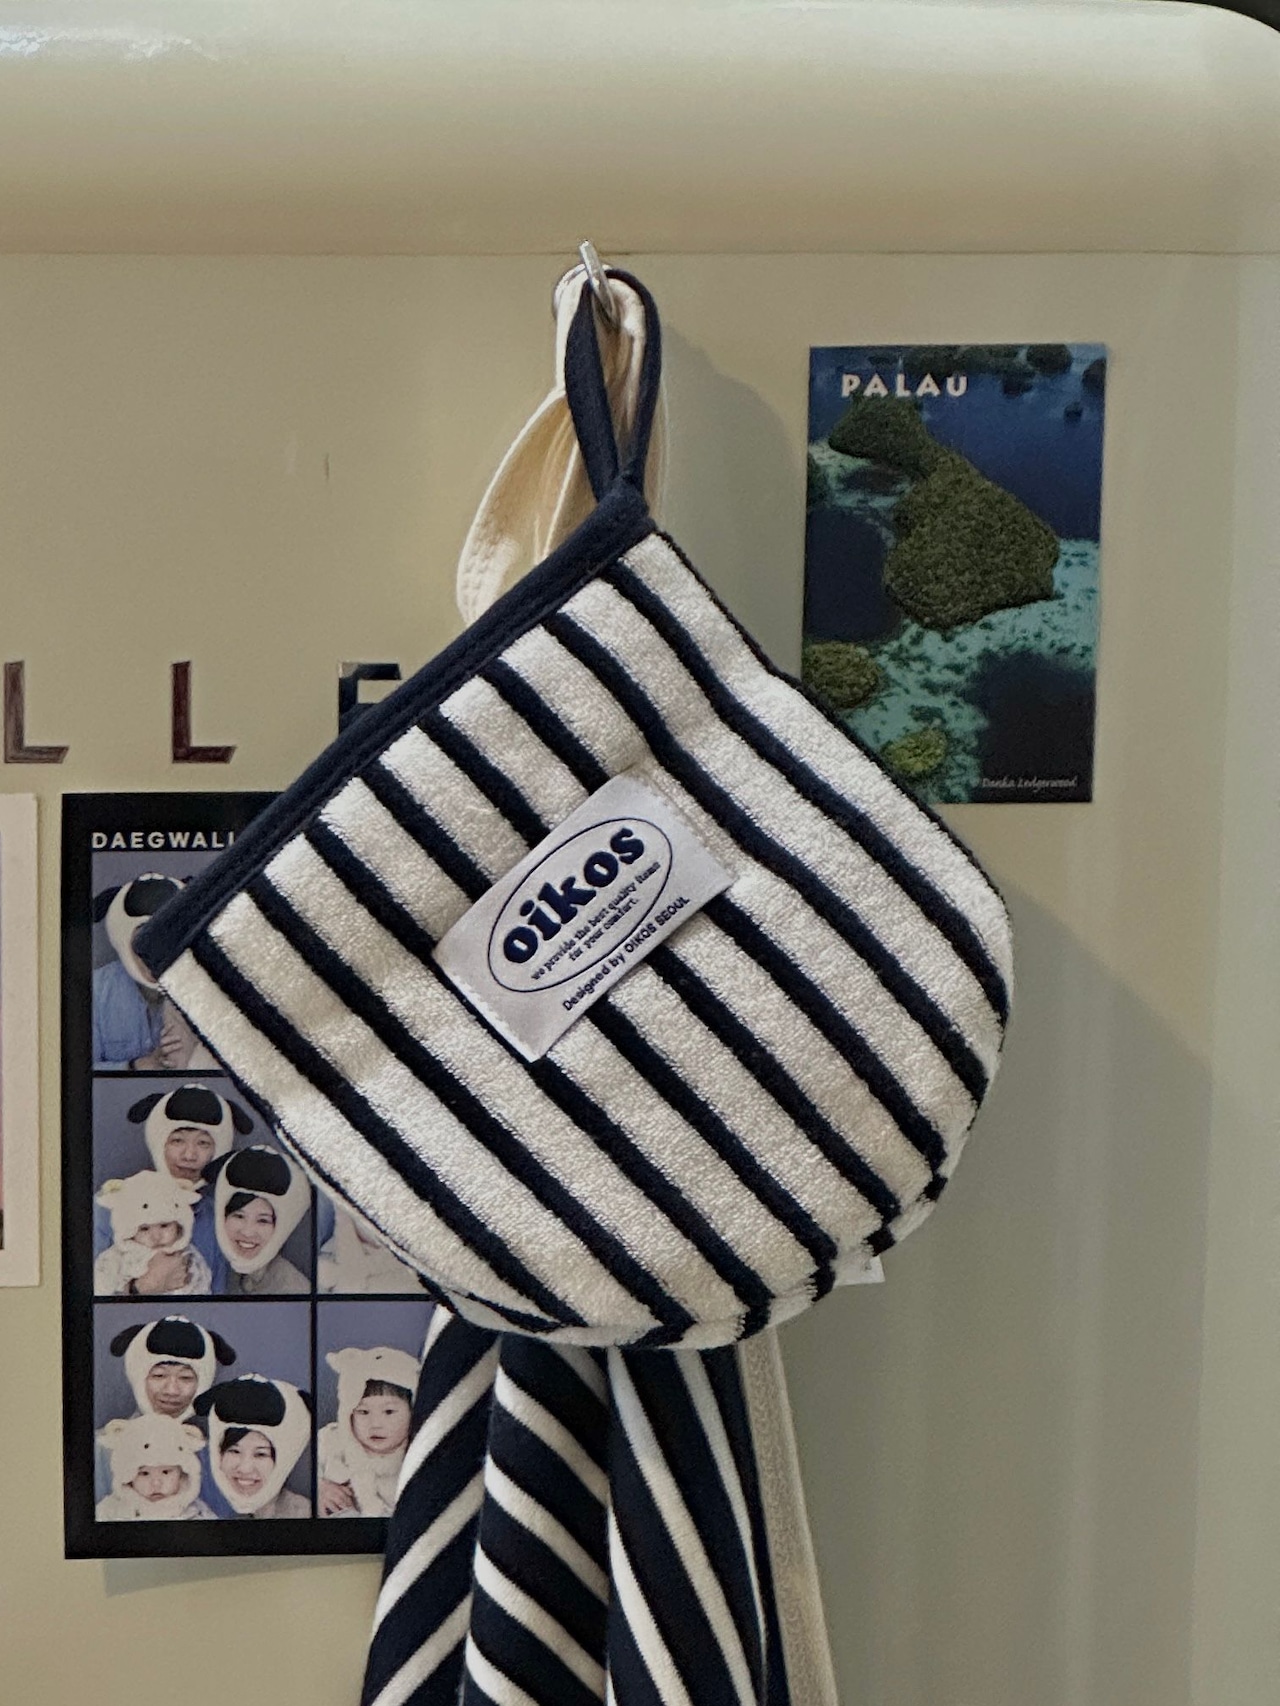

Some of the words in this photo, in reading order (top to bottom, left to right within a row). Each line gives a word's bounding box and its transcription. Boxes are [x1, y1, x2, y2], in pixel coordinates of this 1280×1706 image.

[841, 372, 968, 398] PALAU
[503, 827, 645, 964] oikos
[543, 939, 577, 972] provide
[573, 924, 592, 942] the
[587, 908, 610, 928] best
[607, 882, 638, 911] quality
[583, 928, 605, 950] your
[562, 965, 611, 1012] Designed
[608, 952, 626, 969] by
[624, 922, 658, 955] OIKOS
[655, 896, 691, 928] SEOUL
